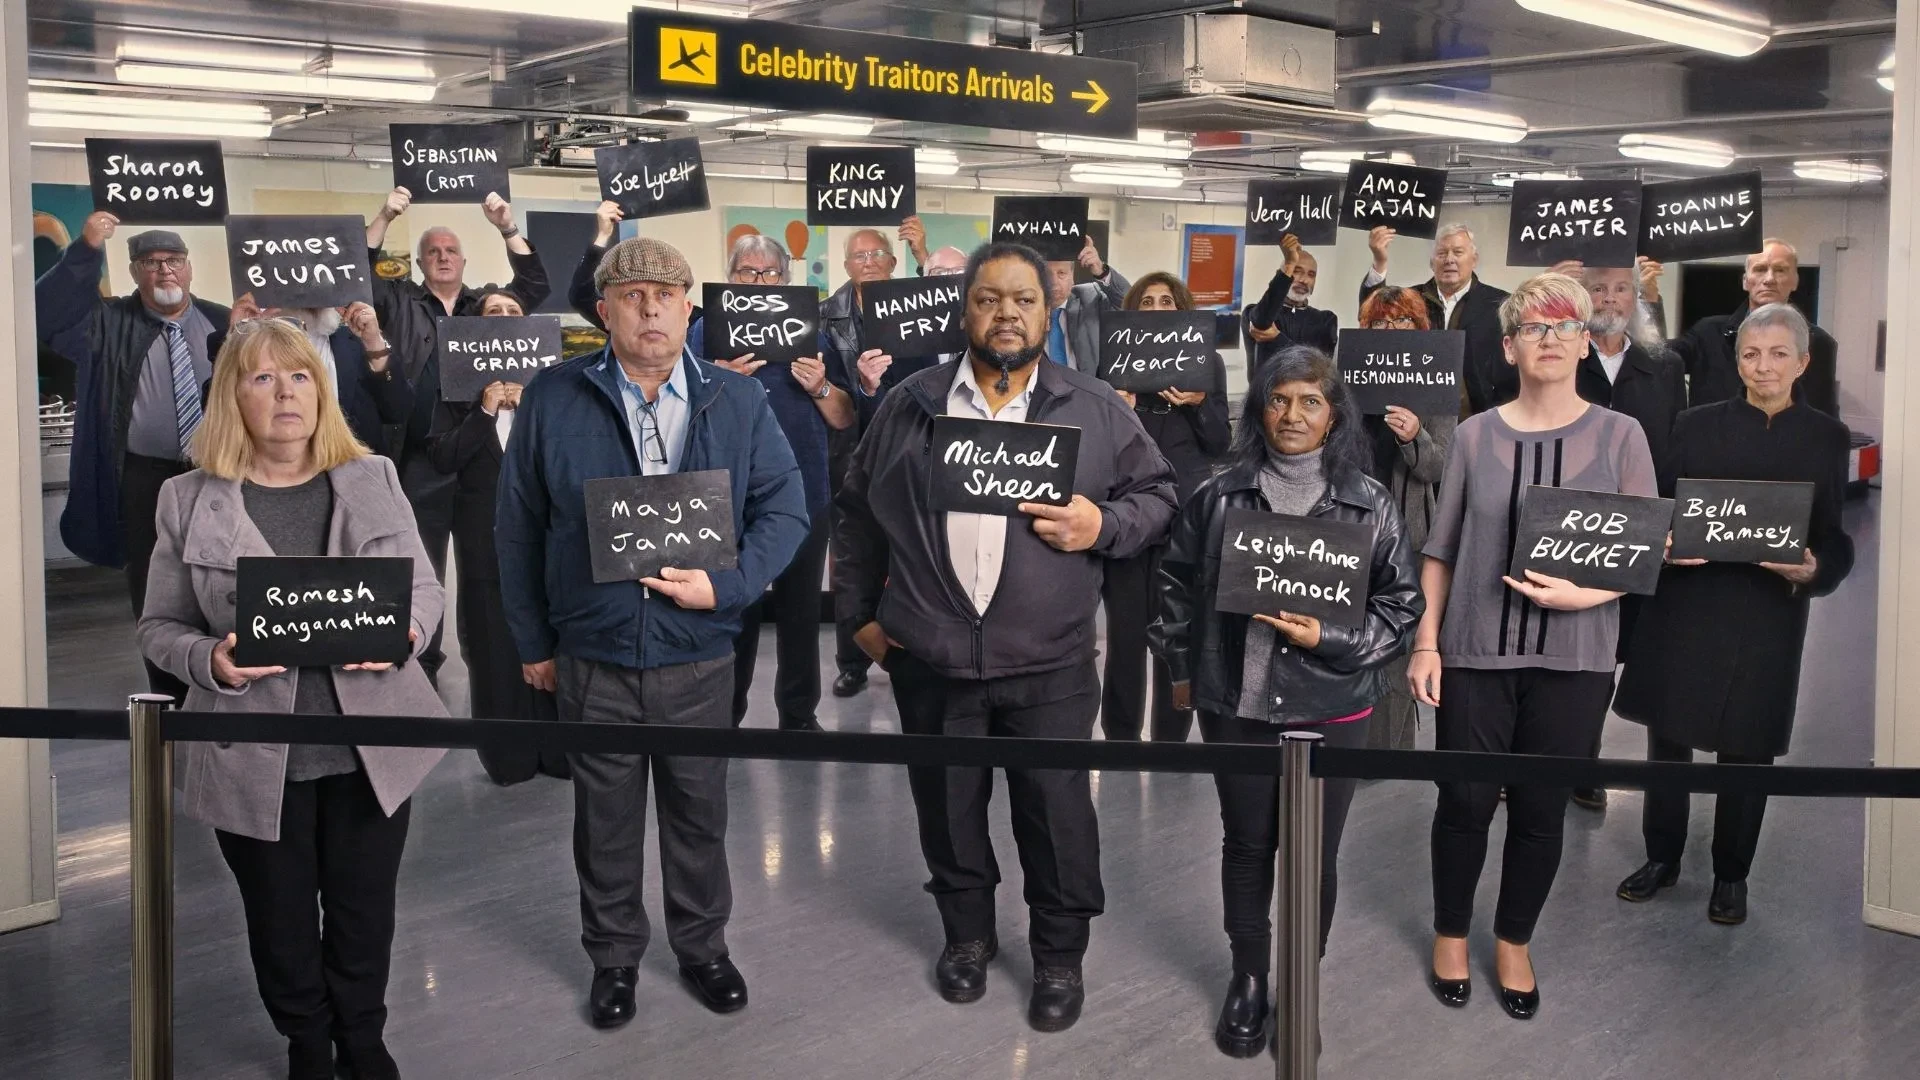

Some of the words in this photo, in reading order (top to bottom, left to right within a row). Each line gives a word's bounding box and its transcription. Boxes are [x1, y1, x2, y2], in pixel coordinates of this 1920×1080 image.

[741, 44, 857, 90] Celebrity
[865, 57, 958, 94] Traitors
[966, 68, 1053, 103] Arrivals
[403, 140, 497, 166] SEBASTIAN
[104, 155, 203, 176] Sharon
[830, 163, 885, 183] KING
[426, 170, 474, 192] CROFT
[610, 172, 640, 195] Joe
[645, 162, 695, 200] Lycett
[1359, 174, 1425, 197] AMOL
[107, 183, 213, 206] Rooney
[818, 185, 903, 210] KENNY
[1658, 191, 1751, 216] JOANNE
[1251, 197, 1293, 231] Jerry
[1301, 195, 1332, 219] Hall
[1354, 199, 1435, 218] RAJAN
[1538, 198, 1613, 217] JAMES
[999, 222, 1079, 236] MYHA'LA
[1521, 218, 1626, 241] ACASTER
[242, 237, 339, 255] JAMES
[722, 290, 788, 313] ROSS
[875, 286, 959, 320] HANNAH
[729, 318, 807, 347] KEMP
[900, 312, 950, 340] FRY
[1108, 326, 1203, 344] Miranda
[474, 355, 556, 371] GRANT
[1109, 350, 1193, 374] Heart
[1366, 353, 1411, 366] JULIE
[1345, 370, 1455, 385] HESMONDHALGH
[944, 436, 1059, 468] Michael
[964, 469, 1061, 500] Sheen
[612, 499, 707, 524] Maya
[1683, 498, 1746, 517] Bella
[1561, 510, 1628, 534] ROB
[612, 528, 721, 552] Jama
[1706, 522, 1791, 547] Ramsey
[1234, 532, 1359, 570] Leigh-Anne
[1530, 536, 1650, 567] BUCKET
[267, 582, 374, 605] Romesh
[1255, 566, 1351, 605] Pinnock
[253, 612, 395, 642] Ranganathan
